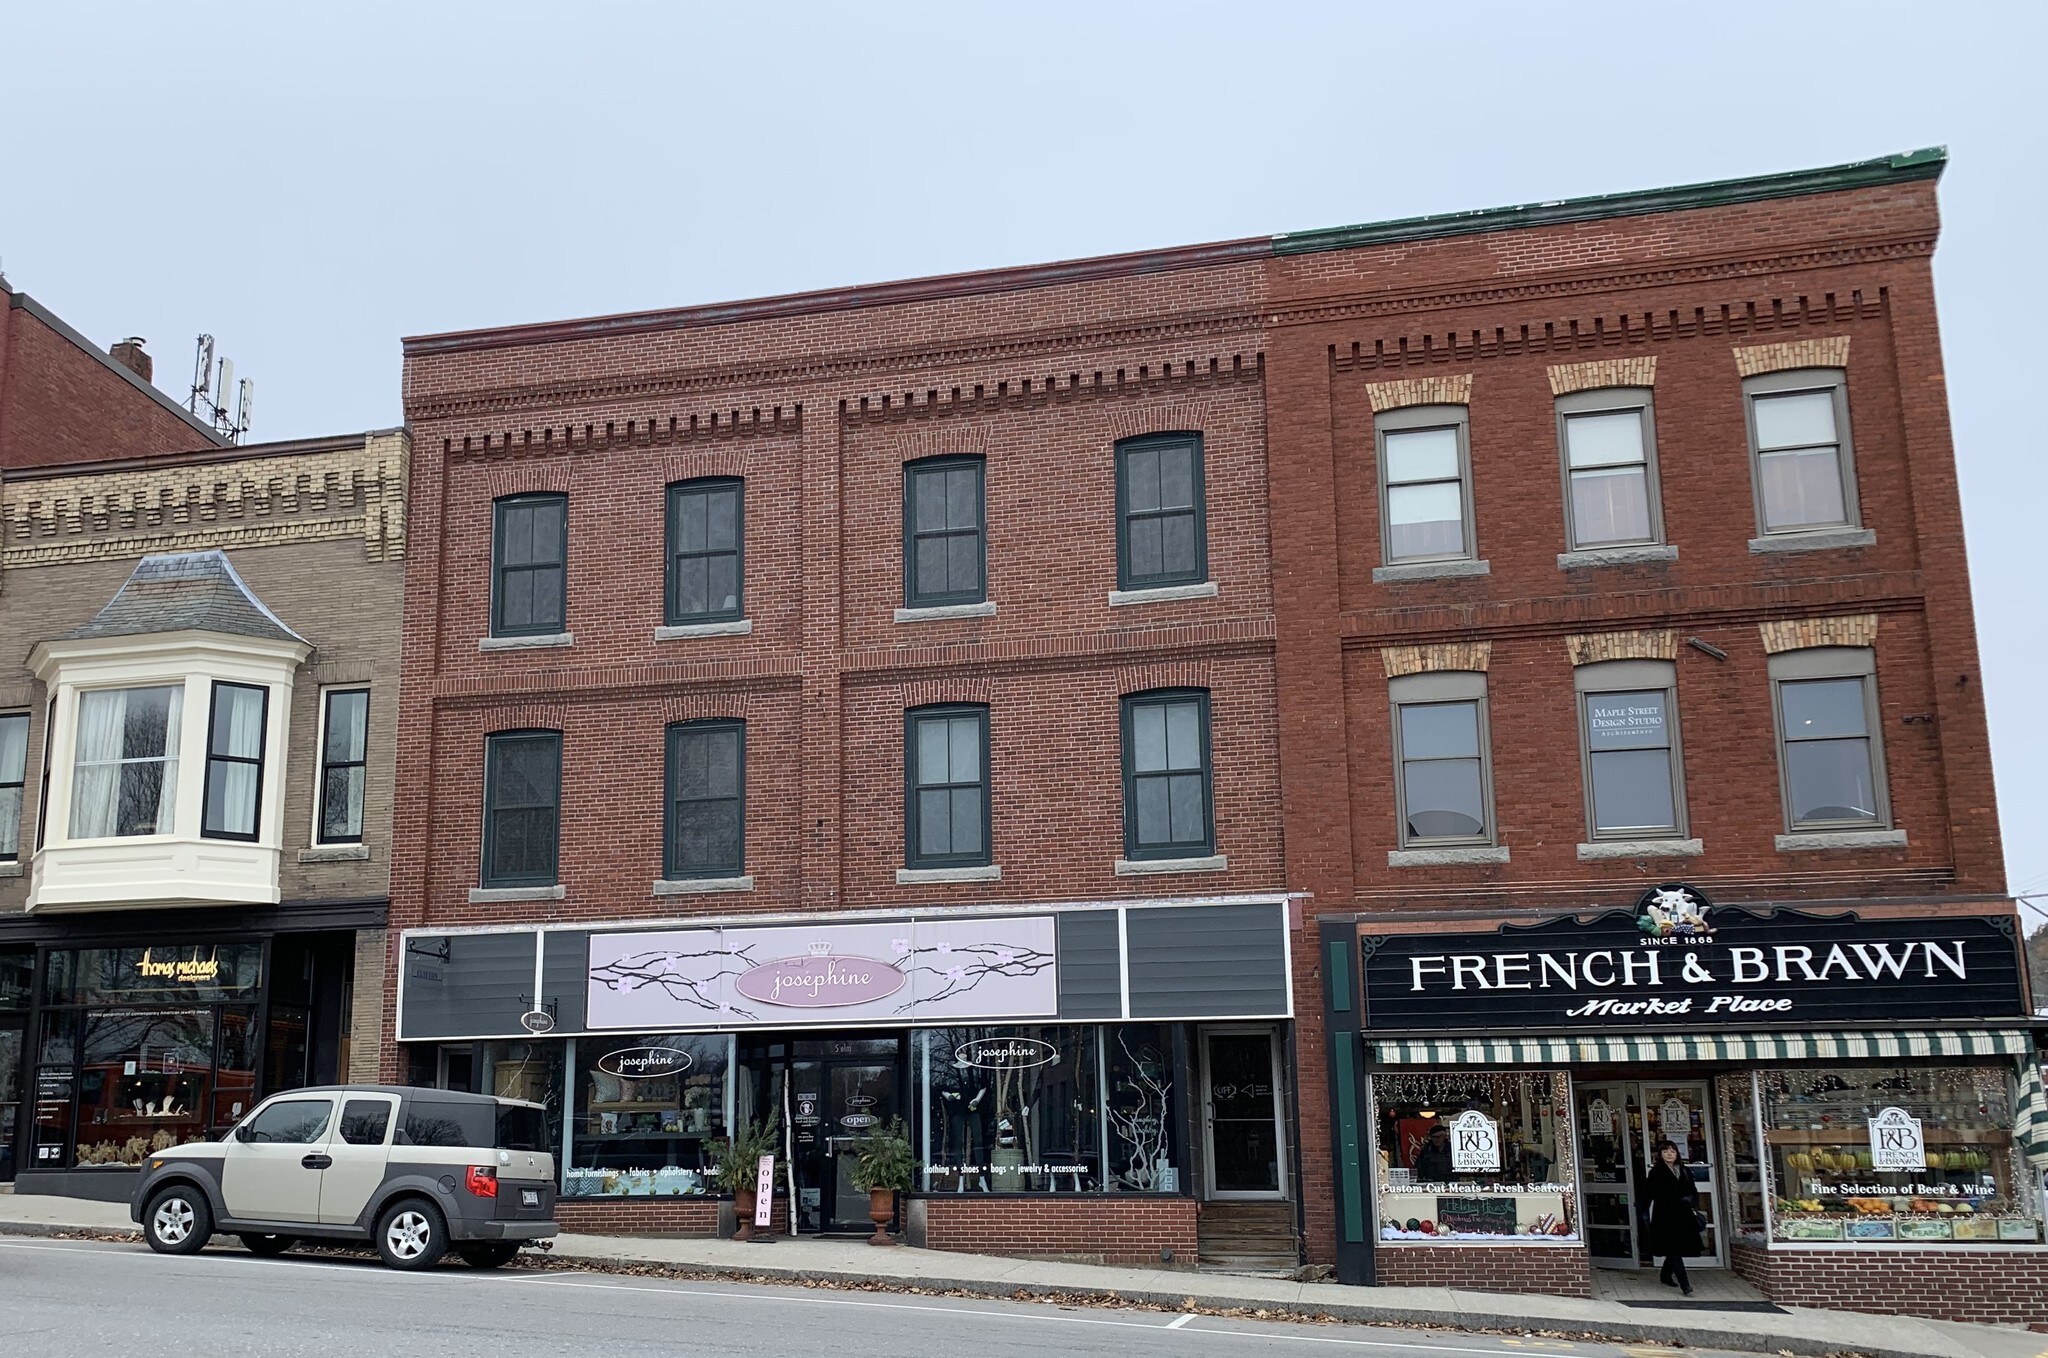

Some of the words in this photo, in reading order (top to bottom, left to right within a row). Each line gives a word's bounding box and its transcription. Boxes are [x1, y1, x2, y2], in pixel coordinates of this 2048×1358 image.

[1594, 708, 1626, 718] MAPLE
[1628, 706, 1658, 716] STREET
[1592, 718, 1626, 728] DESIGN
[1628, 716, 1662, 726] STUDIO
[1640, 937, 1678, 946] SINCE
[1684, 936, 1713, 944] 1868
[136, 946, 175, 978] thomas
[176, 945, 218, 978] michaels
[1408, 950, 1664, 992] FRENCH
[1682, 952, 1716, 983] &
[1728, 941, 1966, 982] BRAWN
[1566, 998, 1692, 1016] Market
[1704, 996, 1792, 1013] Place
[975, 1041, 1036, 1065] josephine
[617, 1050, 674, 1073] josephine
[847, 1116, 871, 1125] open
[1457, 1130, 1493, 1152] F&B
[1877, 1128, 1917, 1151] F&B
[566, 1169, 583, 1178] home
[585, 1168, 619, 1178] furnishings
[629, 1167, 650, 1177] fabrics
[660, 1167, 693, 1178] upholstery
[923, 1163, 949, 1176] clothing
[961, 1163, 979, 1173] shoes
[990, 1163, 1006, 1175] bags
[1018, 1163, 1043, 1174] jewelry
[1044, 1164, 1049, 1173] &
[1052, 1163, 1088, 1173] accessories
[1382, 1184, 1423, 1193] Custom
[1427, 1184, 1446, 1193] Cut
[1450, 1184, 1481, 1193] Meats
[1494, 1184, 1524, 1193] Fresh
[1527, 1183, 1573, 1193] Seafood
[1811, 1184, 1837, 1194] Fine
[1840, 1184, 1897, 1195] Selection
[1900, 1184, 1914, 1194] of
[1917, 1184, 1946, 1195] Beer
[1950, 1184, 1959, 1195] &
[1962, 1184, 1995, 1195] Wine
